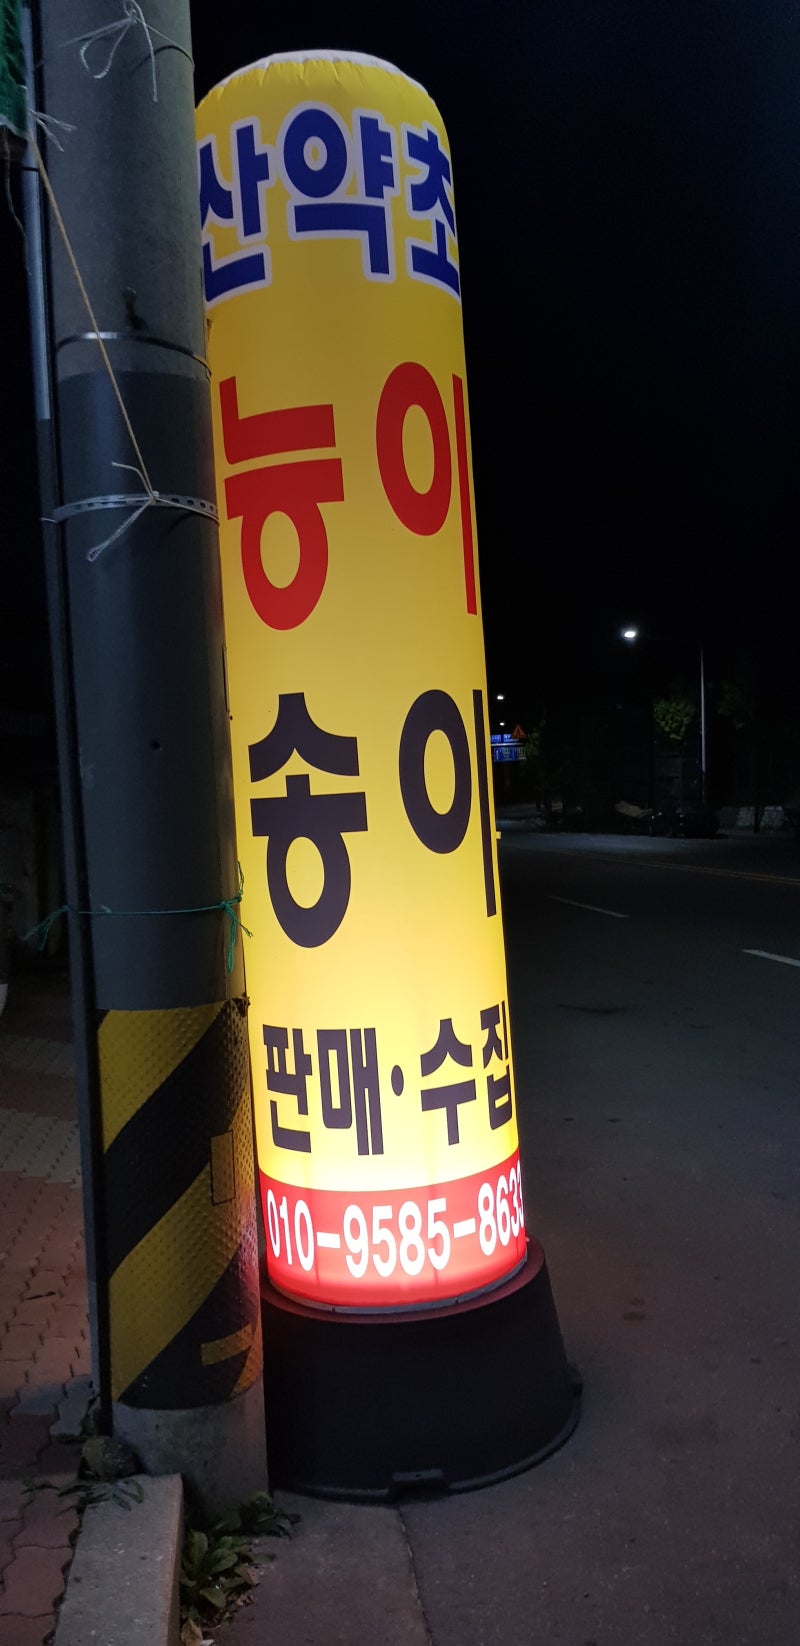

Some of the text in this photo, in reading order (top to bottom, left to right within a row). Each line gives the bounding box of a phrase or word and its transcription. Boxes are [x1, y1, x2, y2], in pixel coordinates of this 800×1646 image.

[198, 104, 460, 303] 산약초
[219, 361, 477, 631] 능이
[248, 689, 497, 948] 송이
